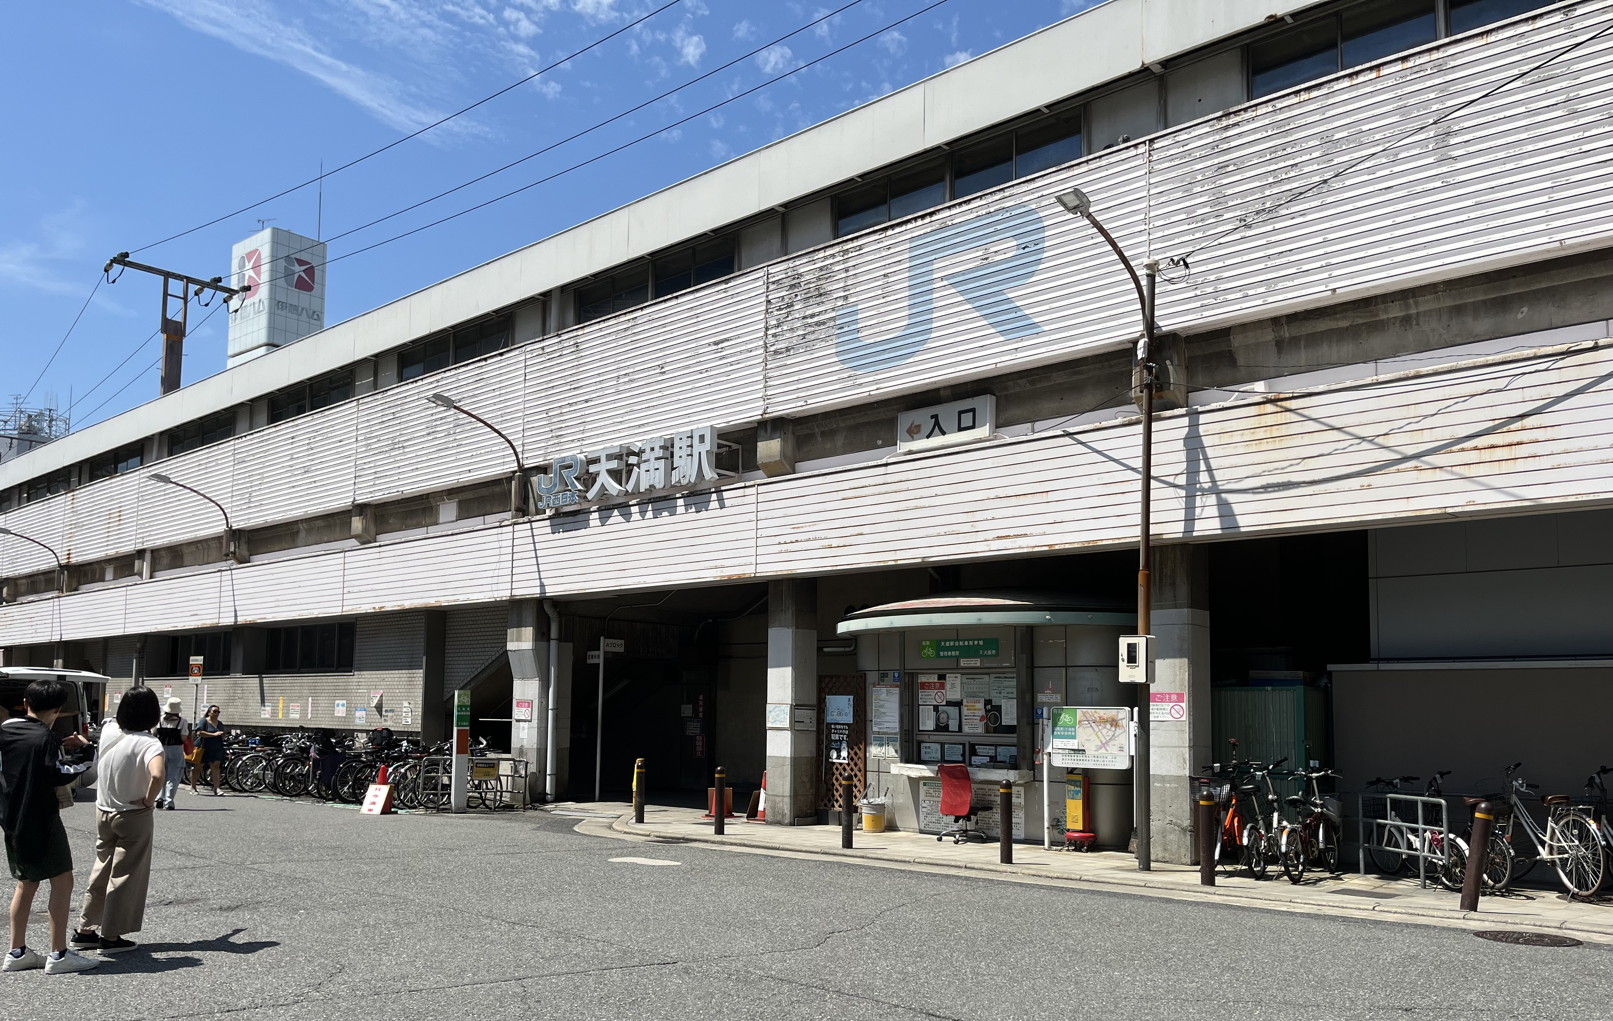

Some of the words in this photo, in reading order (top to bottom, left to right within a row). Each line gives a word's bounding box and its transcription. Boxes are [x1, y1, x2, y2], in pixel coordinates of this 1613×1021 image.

[835, 204, 1045, 373] JR
[925, 407, 977, 440] 入口
[537, 453, 587, 496] JR
[585, 425, 719, 501] 天満駅
[537, 490, 579, 509] JR西日本
[1155, 693, 1178, 702] ご注意
